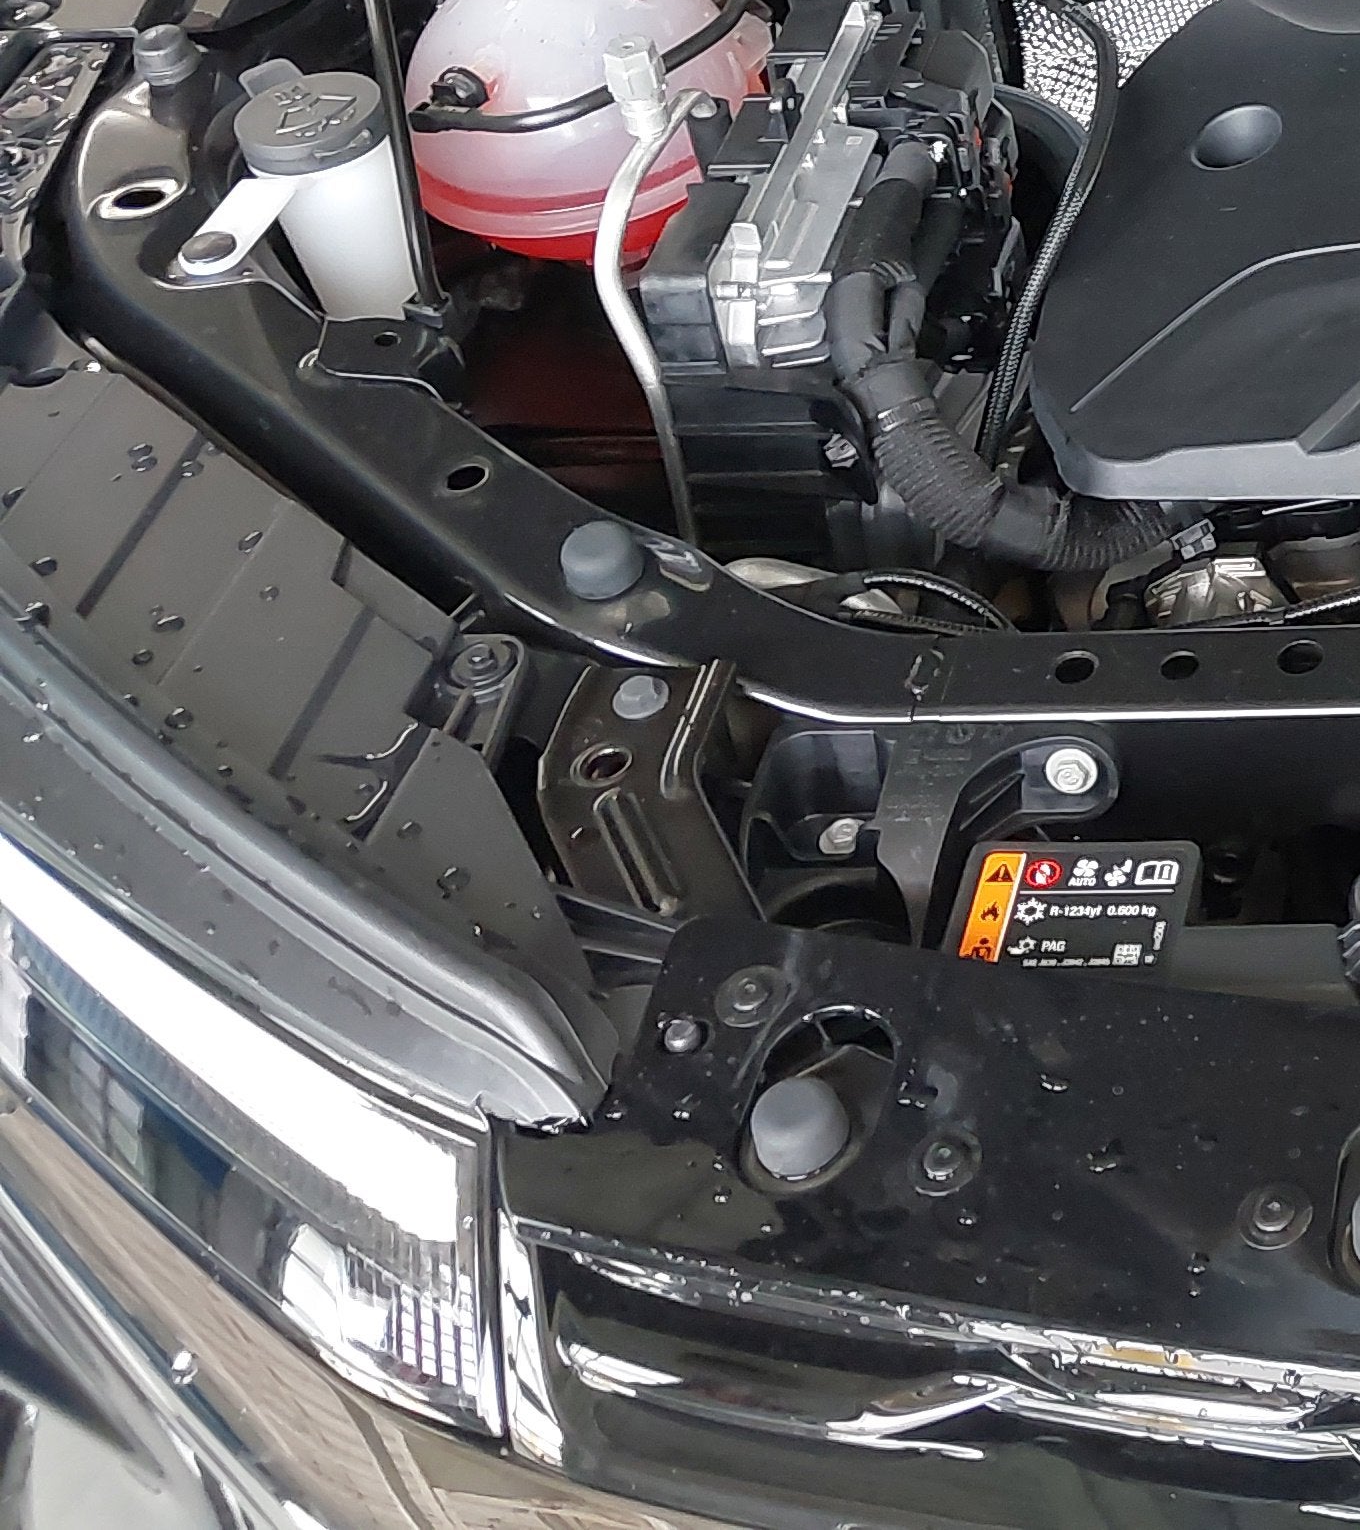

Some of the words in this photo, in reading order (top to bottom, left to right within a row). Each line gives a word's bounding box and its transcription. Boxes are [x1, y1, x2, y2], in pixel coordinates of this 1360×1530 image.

[1067, 877, 1097, 887] AUTO
[1141, 904, 1157, 918] kg
[1040, 940, 1067, 953] PAG
